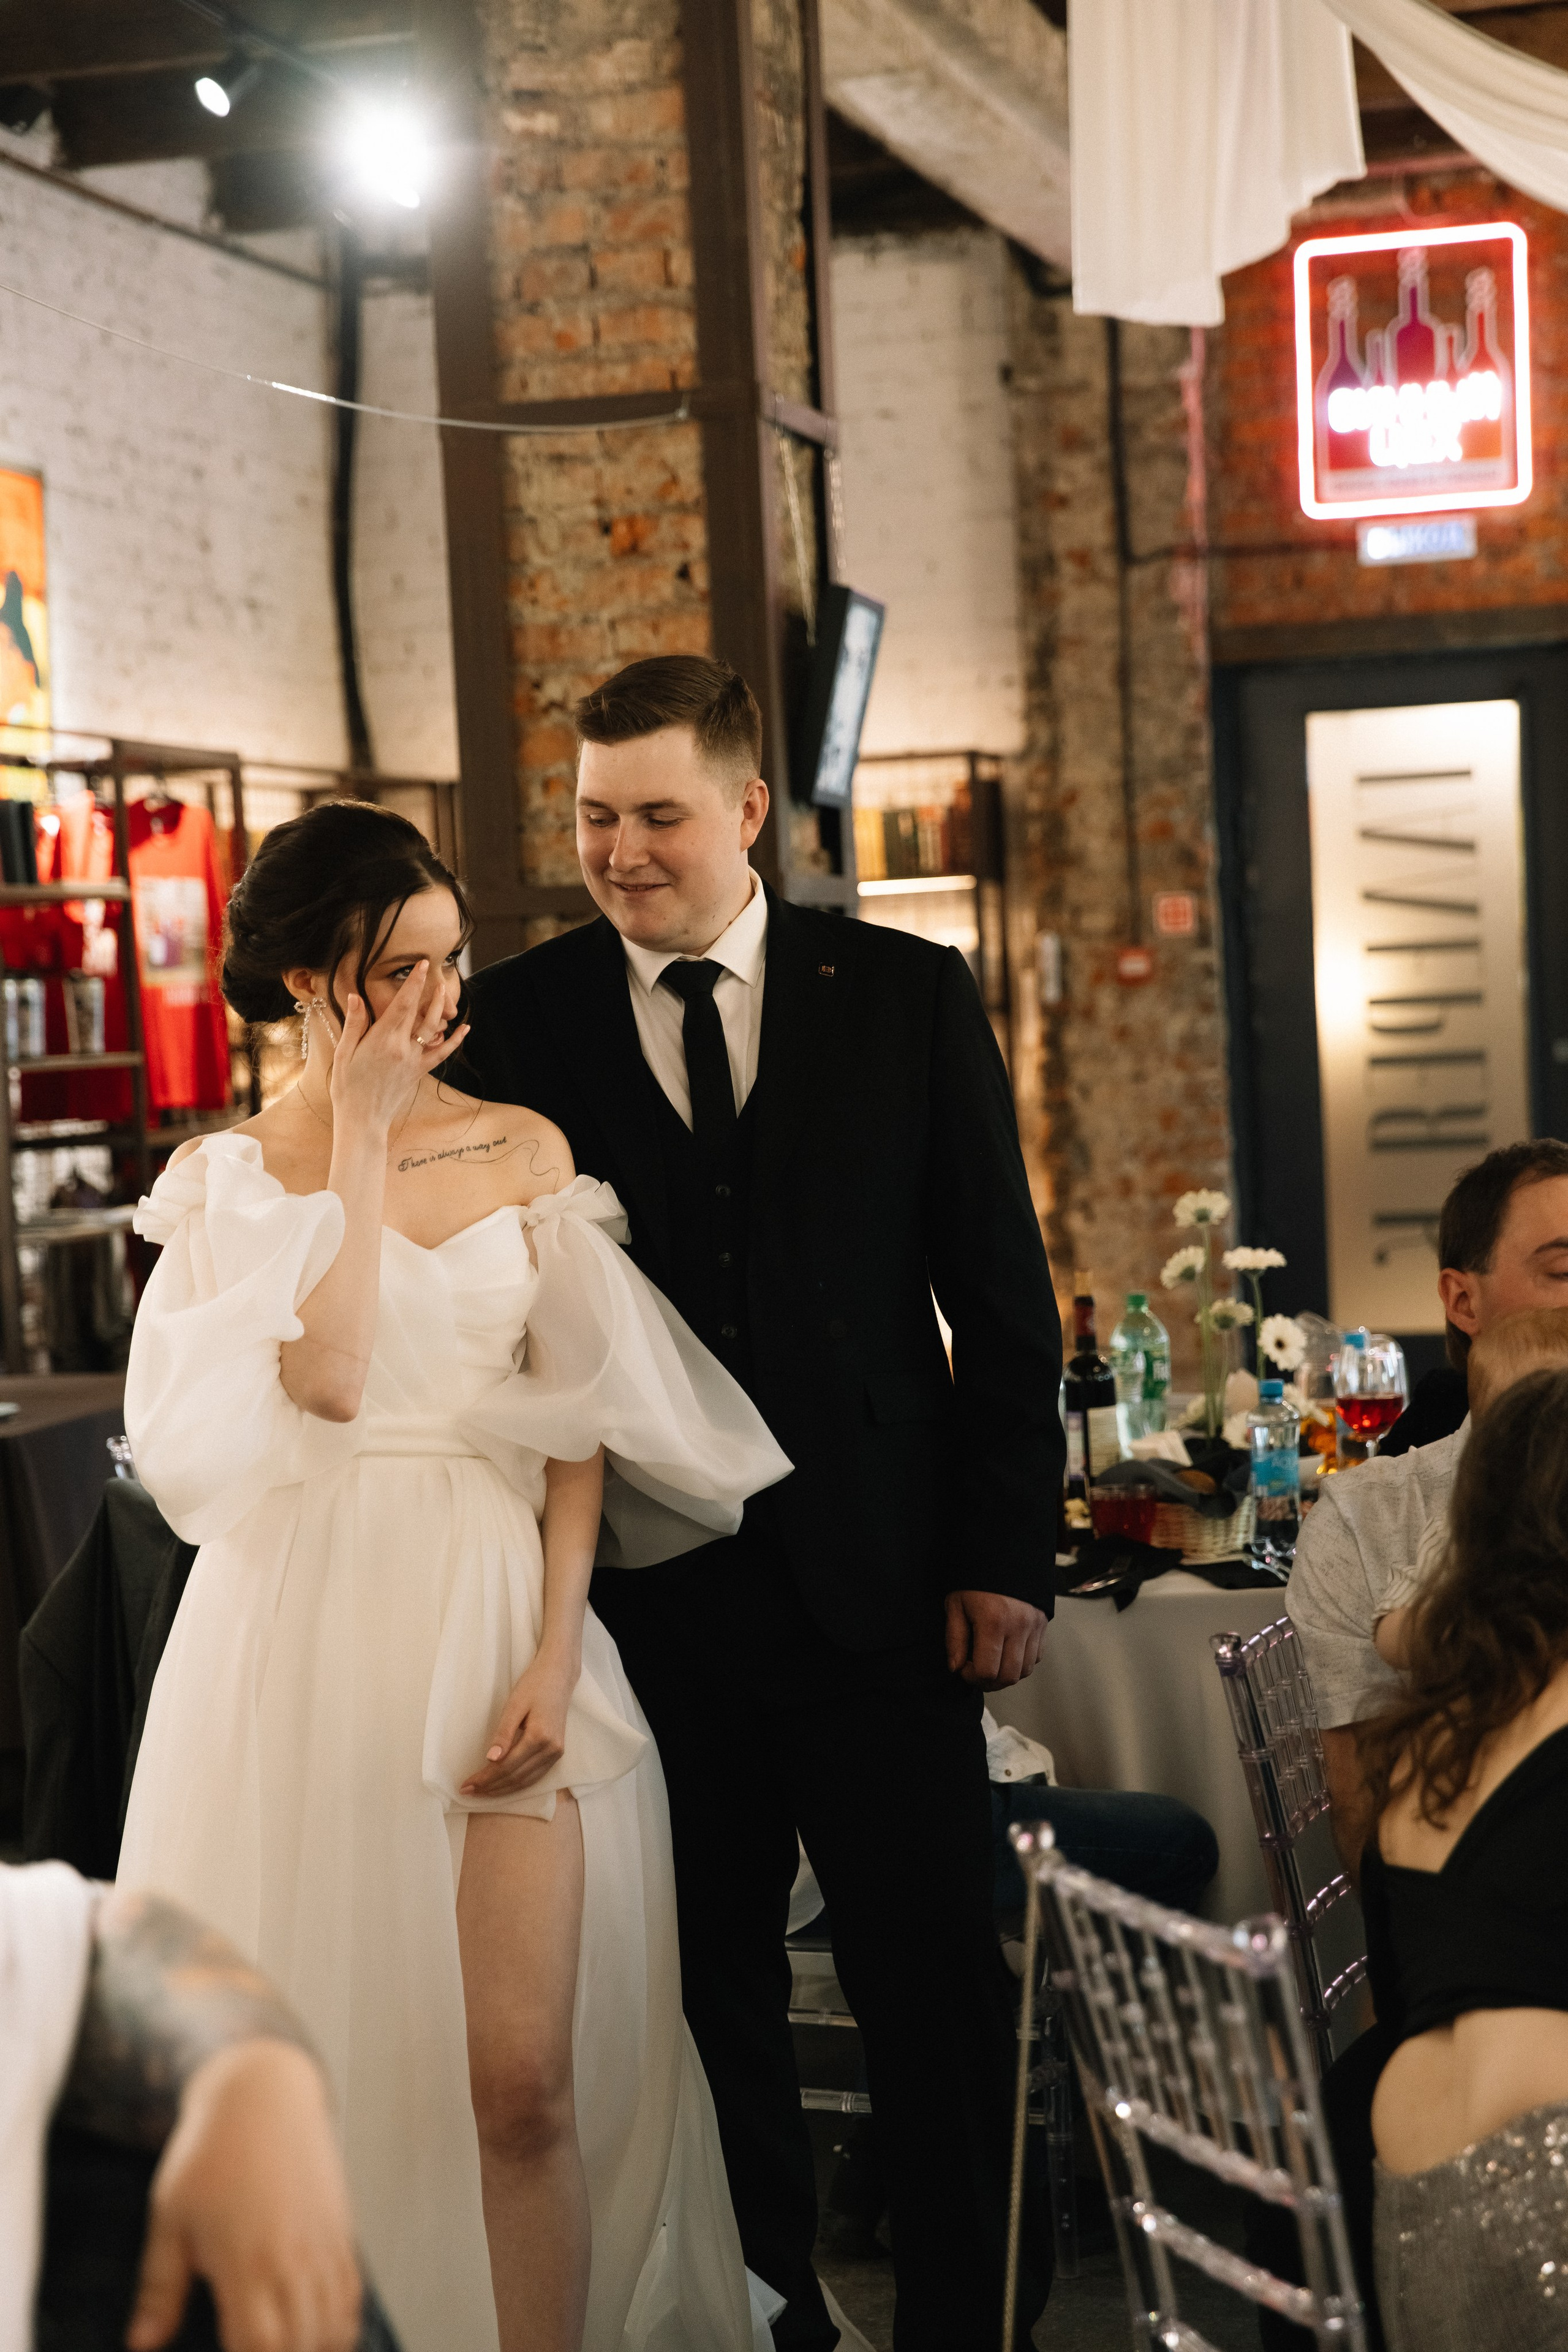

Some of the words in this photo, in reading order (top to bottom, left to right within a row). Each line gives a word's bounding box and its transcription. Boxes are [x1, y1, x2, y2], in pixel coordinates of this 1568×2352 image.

[398, 1157, 427, 1172] There
[429, 1153, 435, 1162] is
[437, 1147, 464, 1159] always
[473, 1144, 491, 1153] way
[492, 1136, 507, 1147] out
